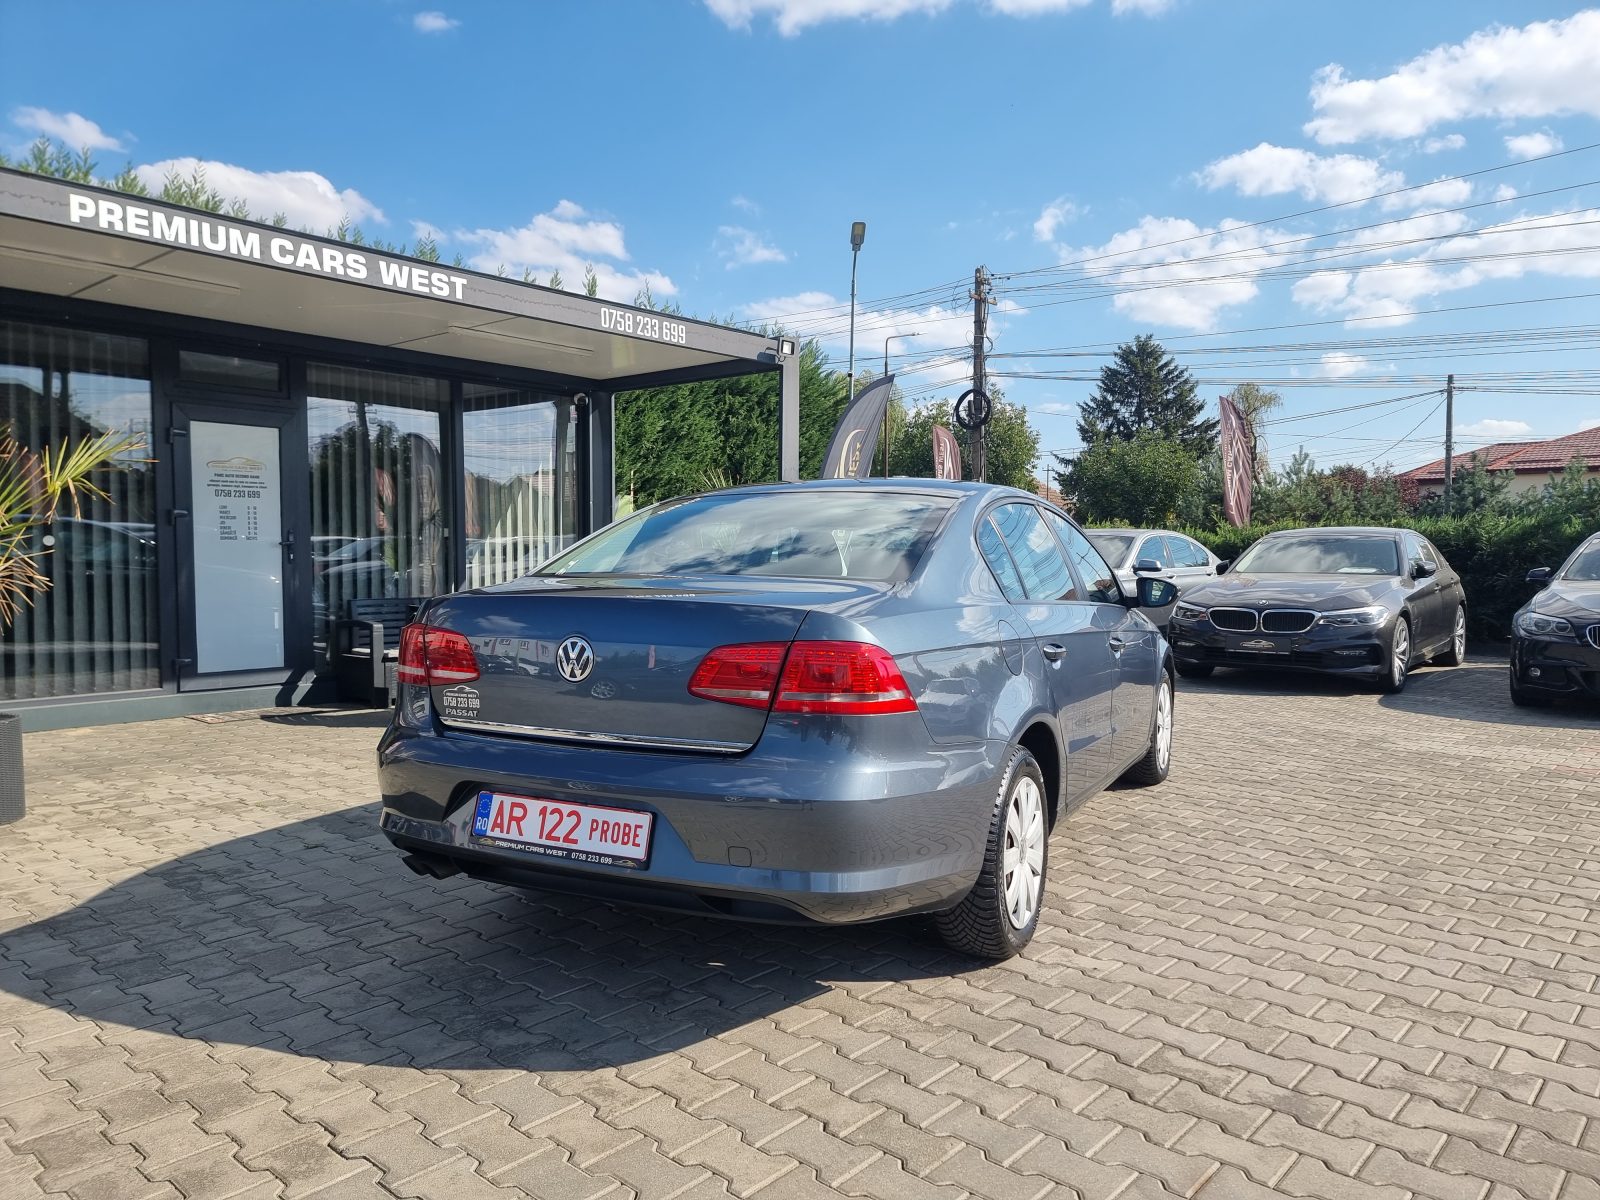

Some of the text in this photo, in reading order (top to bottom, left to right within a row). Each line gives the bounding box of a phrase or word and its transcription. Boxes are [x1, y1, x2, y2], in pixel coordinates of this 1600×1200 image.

[69, 193, 467, 300] PREMIUM CARS WEST
[601, 307, 686, 344] 0758 233 699
[214, 489, 261, 499] 0758 233 699
[443, 697, 480, 709] 0758 233 699
[446, 707, 478, 717] PASSAT
[476, 816, 488, 830] RO
[490, 800, 643, 847] AR 122 PROBE
[495, 840, 568, 857] PREMIUM CARS WEST
[571, 851, 613, 865] 0758 233 699
